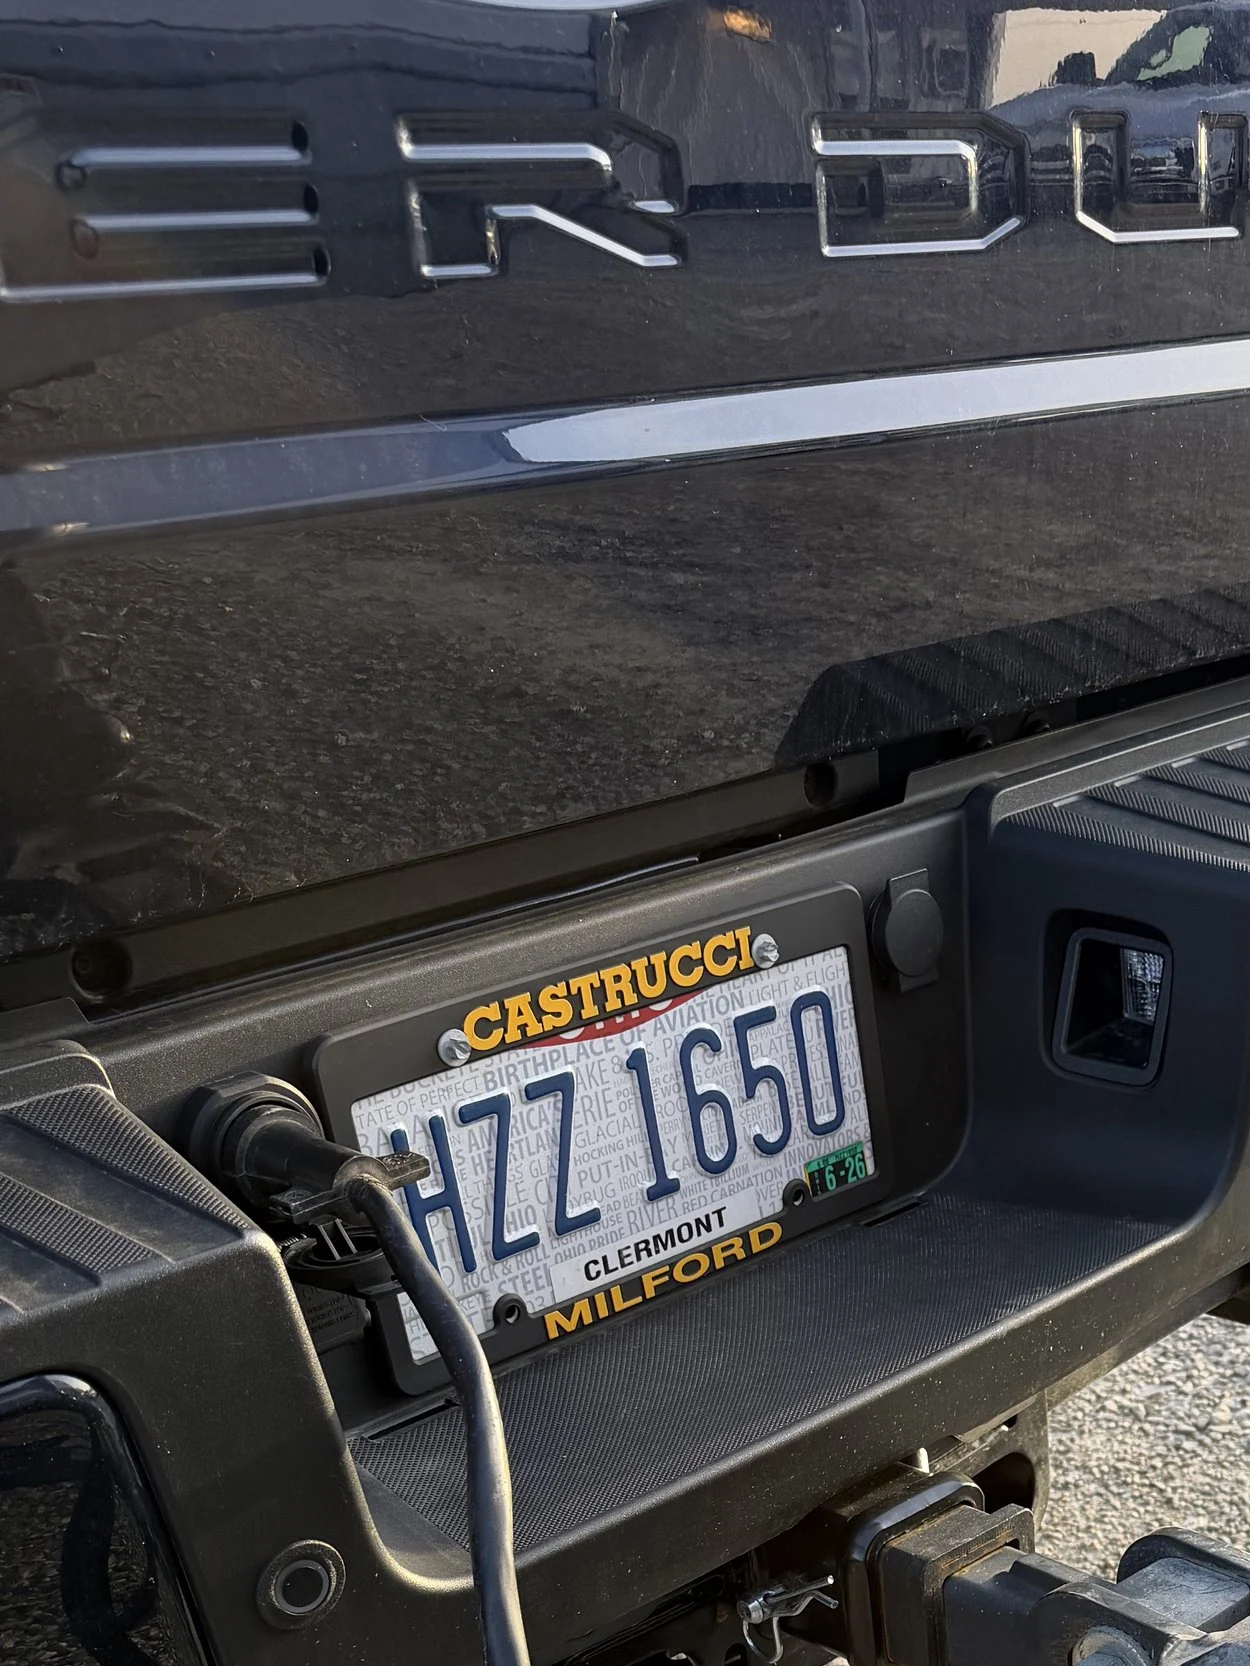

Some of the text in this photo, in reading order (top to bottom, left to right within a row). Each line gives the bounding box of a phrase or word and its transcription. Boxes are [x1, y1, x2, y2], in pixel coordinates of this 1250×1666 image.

[462, 926, 754, 1052] CASTRUCCI
[419, 1074, 482, 1109] PERFECT
[481, 1030, 616, 1093] BIRTHPLACE
[618, 1024, 647, 1048] OF
[650, 988, 745, 1038] AVIATION
[748, 978, 790, 1006] LIGHT
[391, 989, 848, 1276] HZZ 1650
[572, 1111, 641, 1150] GLACIAL
[573, 1138, 624, 1167] HOCKING
[782, 1123, 861, 1169] INNOVATORS
[679, 1178, 707, 1199] WHITE
[709, 1162, 750, 1188] TRILLIUM
[681, 1193, 708, 1214] RED
[709, 1162, 783, 1204] CARNATION
[549, 1211, 623, 1250] LIGHTHOUSE
[625, 1193, 678, 1235] RIVER
[461, 1261, 499, 1293] ROCK
[513, 1241, 551, 1271] ROLL
[552, 1225, 626, 1265] OHIO PRIDE
[584, 1205, 728, 1282] CLERMONT
[544, 1221, 784, 1341] MILFORD
